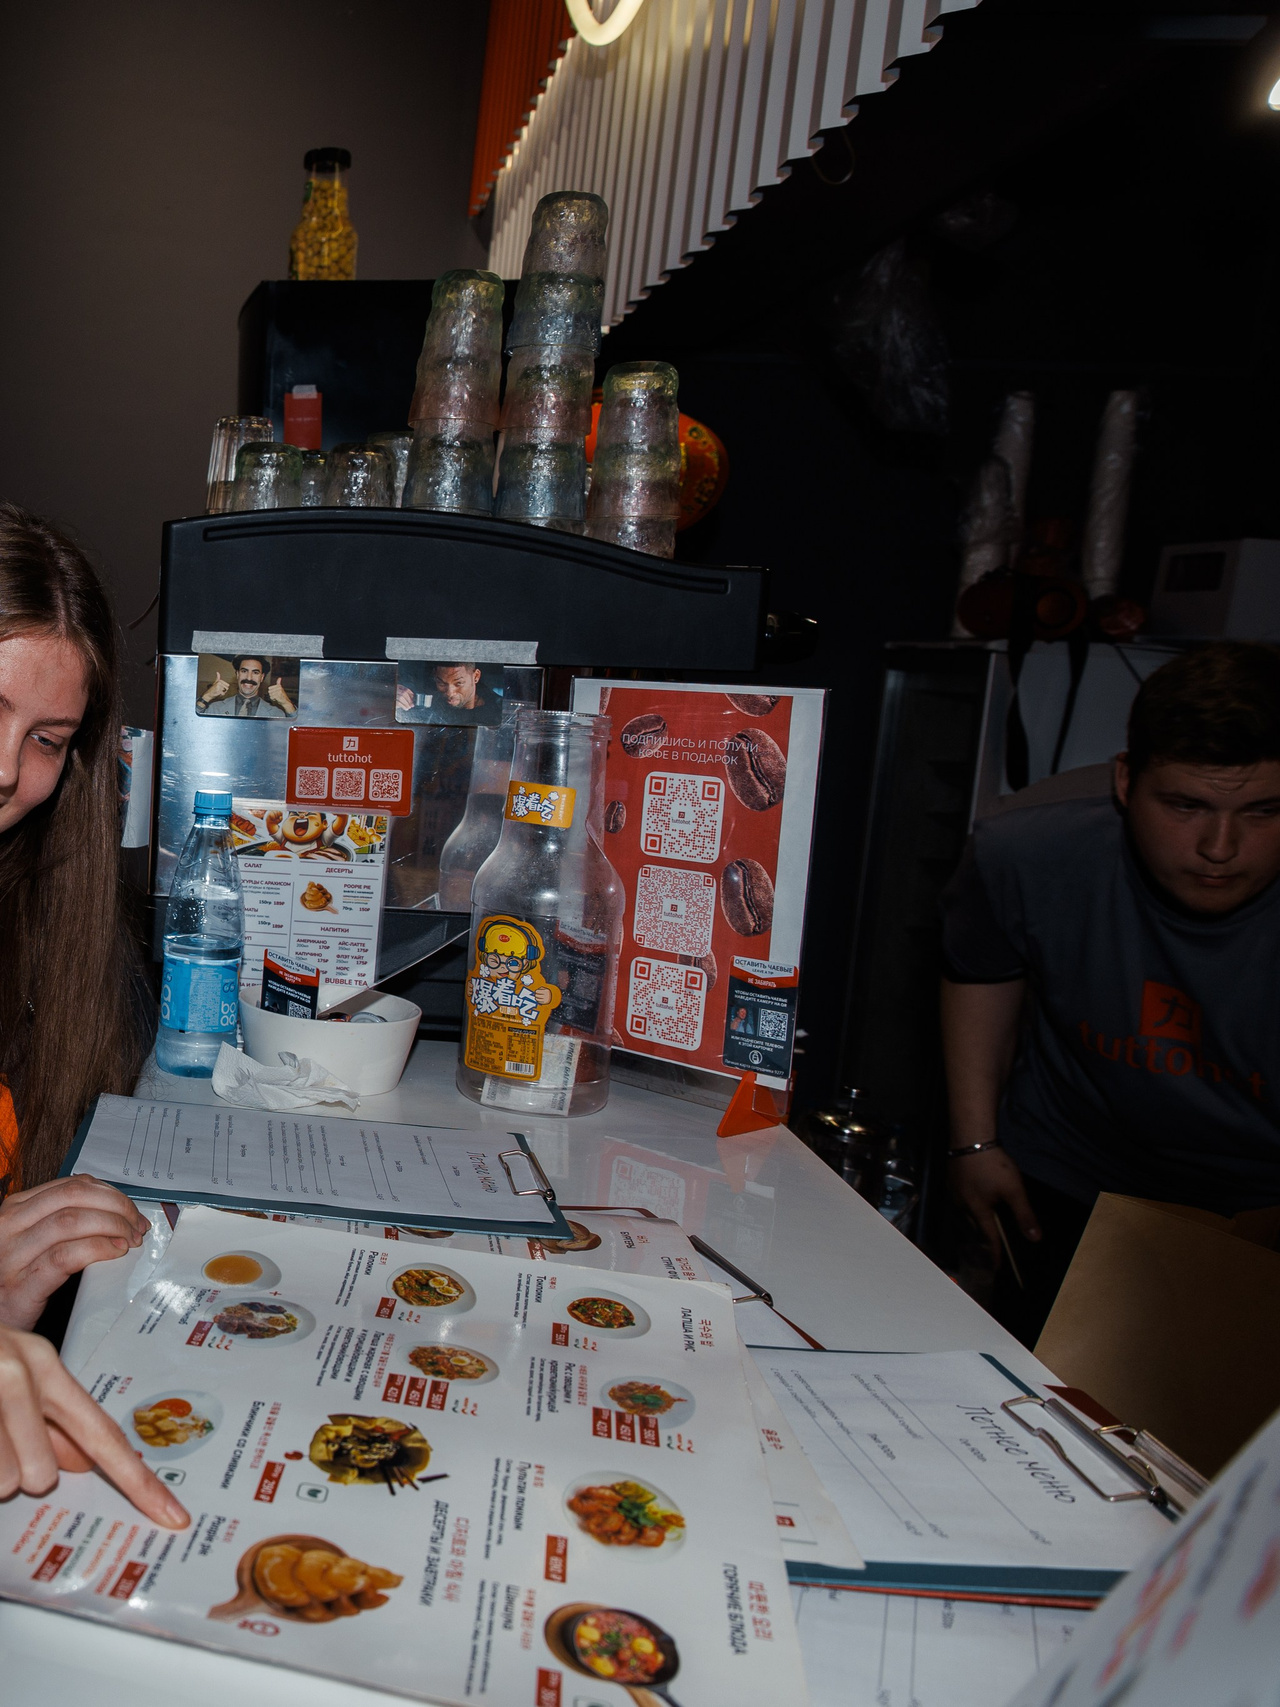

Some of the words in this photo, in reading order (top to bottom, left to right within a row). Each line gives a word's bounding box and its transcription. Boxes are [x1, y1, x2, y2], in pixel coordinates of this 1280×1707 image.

[622, 733, 695, 748] ПОДПИШИСЬ
[698, 740, 706, 748] И
[709, 740, 759, 752] ПОЛУЧИ
[328, 752, 373, 764] tuttohot
[638, 749, 669, 760] КОФЕ
[672, 751, 679, 760] В
[682, 752, 738, 765] ПОДАРОК
[663, 911, 683, 919] tuttohot
[268, 951, 294, 965] ОСТАВИТЬ
[295, 962, 315, 974] ЧАЕВЫЕ
[735, 958, 767, 969] ОСТАВИТЬ
[768, 964, 793, 974] ЧАЕВЫЕ
[354, 978, 368, 986] TEA
[734, 994, 756, 1002] НАВЕДИТЕ
[749, 992, 771, 1000] ОСТАВИТЬ
[1078, 1020, 1266, 1099] tuttoht
[620, 1231, 636, 1249] БУРГЕРЫ
[364, 1251, 379, 1276] Рапокки
[534, 1276, 548, 1303] Токпокки
[681, 1307, 694, 1333] ЛАПША
[683, 1340, 696, 1352] РИС
[242, 1401, 265, 1437] Блинчики
[237, 1438, 248, 1448] со
[956, 1404, 1029, 1463] Летнее
[220, 1449, 245, 1489] сливками
[430, 1500, 450, 1545] ДЕСЕРТЫ
[419, 1556, 441, 1606] ЗАВТРАКИ
[723, 1563, 744, 1612] ГОРЯЧИЕ
[728, 1612, 749, 1655] БЛЮДА
